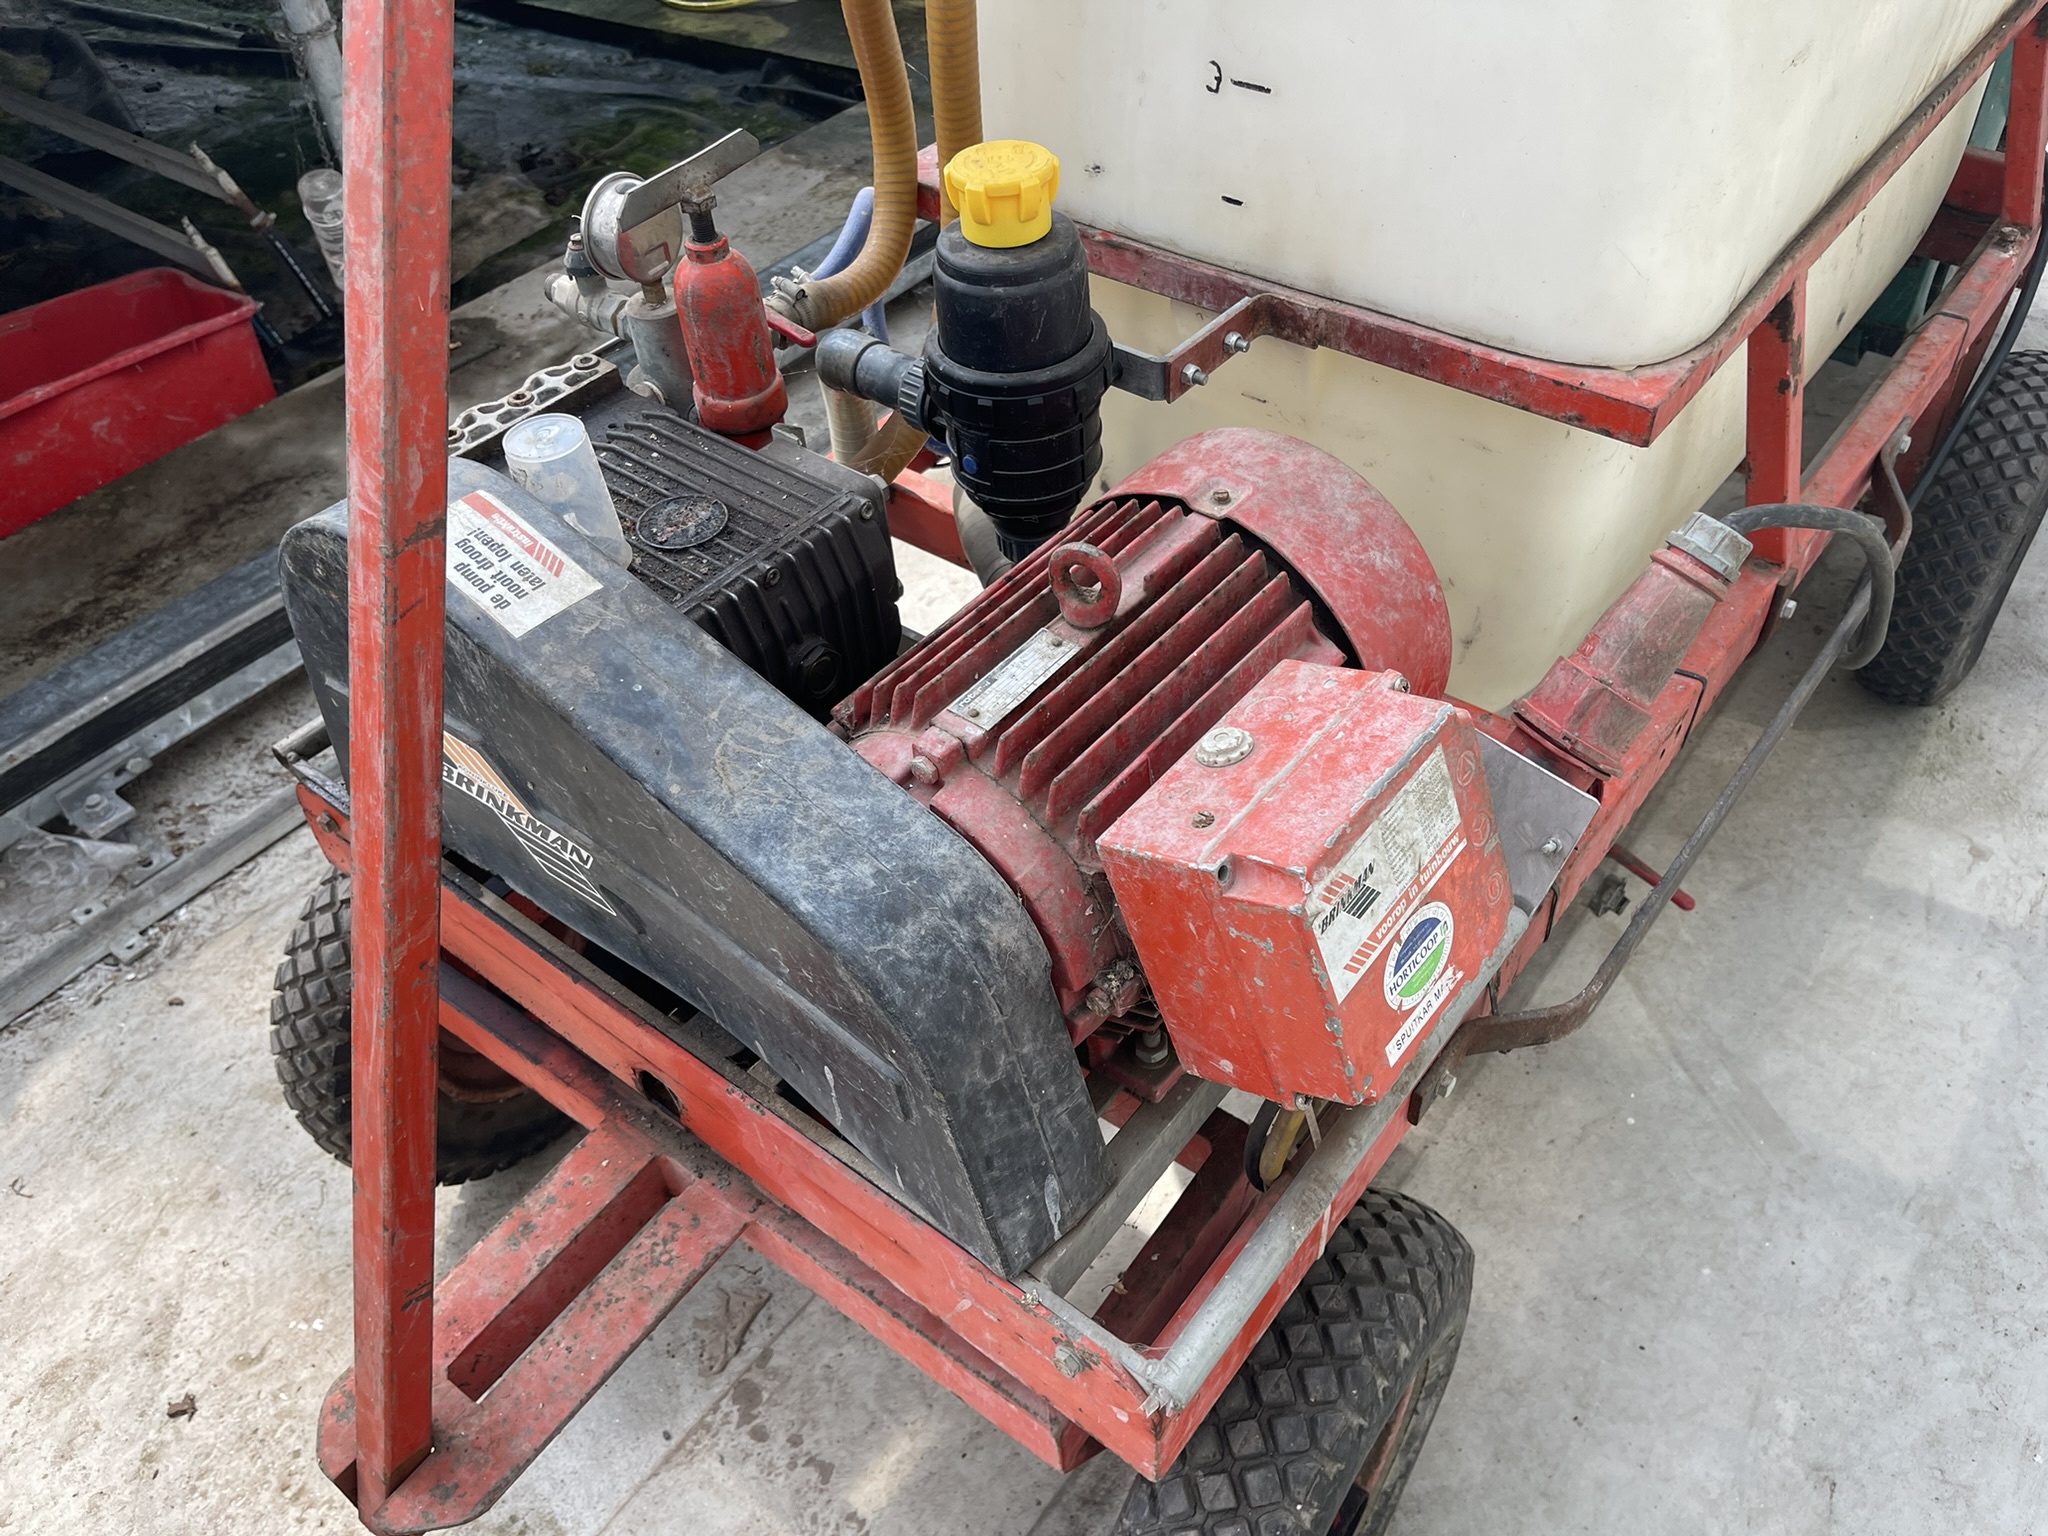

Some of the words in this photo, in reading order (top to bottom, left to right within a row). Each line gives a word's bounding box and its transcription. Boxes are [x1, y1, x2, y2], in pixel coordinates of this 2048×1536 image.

[454, 538, 495, 571] droog
[466, 527, 513, 563] lopen!
[453, 562, 496, 594] pomp
[489, 570, 529, 600] nooit
[510, 560, 547, 591] laten
[489, 594, 512, 610] de
[443, 766, 593, 869] BRINKMAN
[1375, 898, 1407, 940] voorop
[1407, 884, 1419, 900] in
[1419, 832, 1461, 885] tuinbouw
[1389, 932, 1439, 996] HORTICOOP
[1395, 1000, 1433, 1051] SPUITKAR
